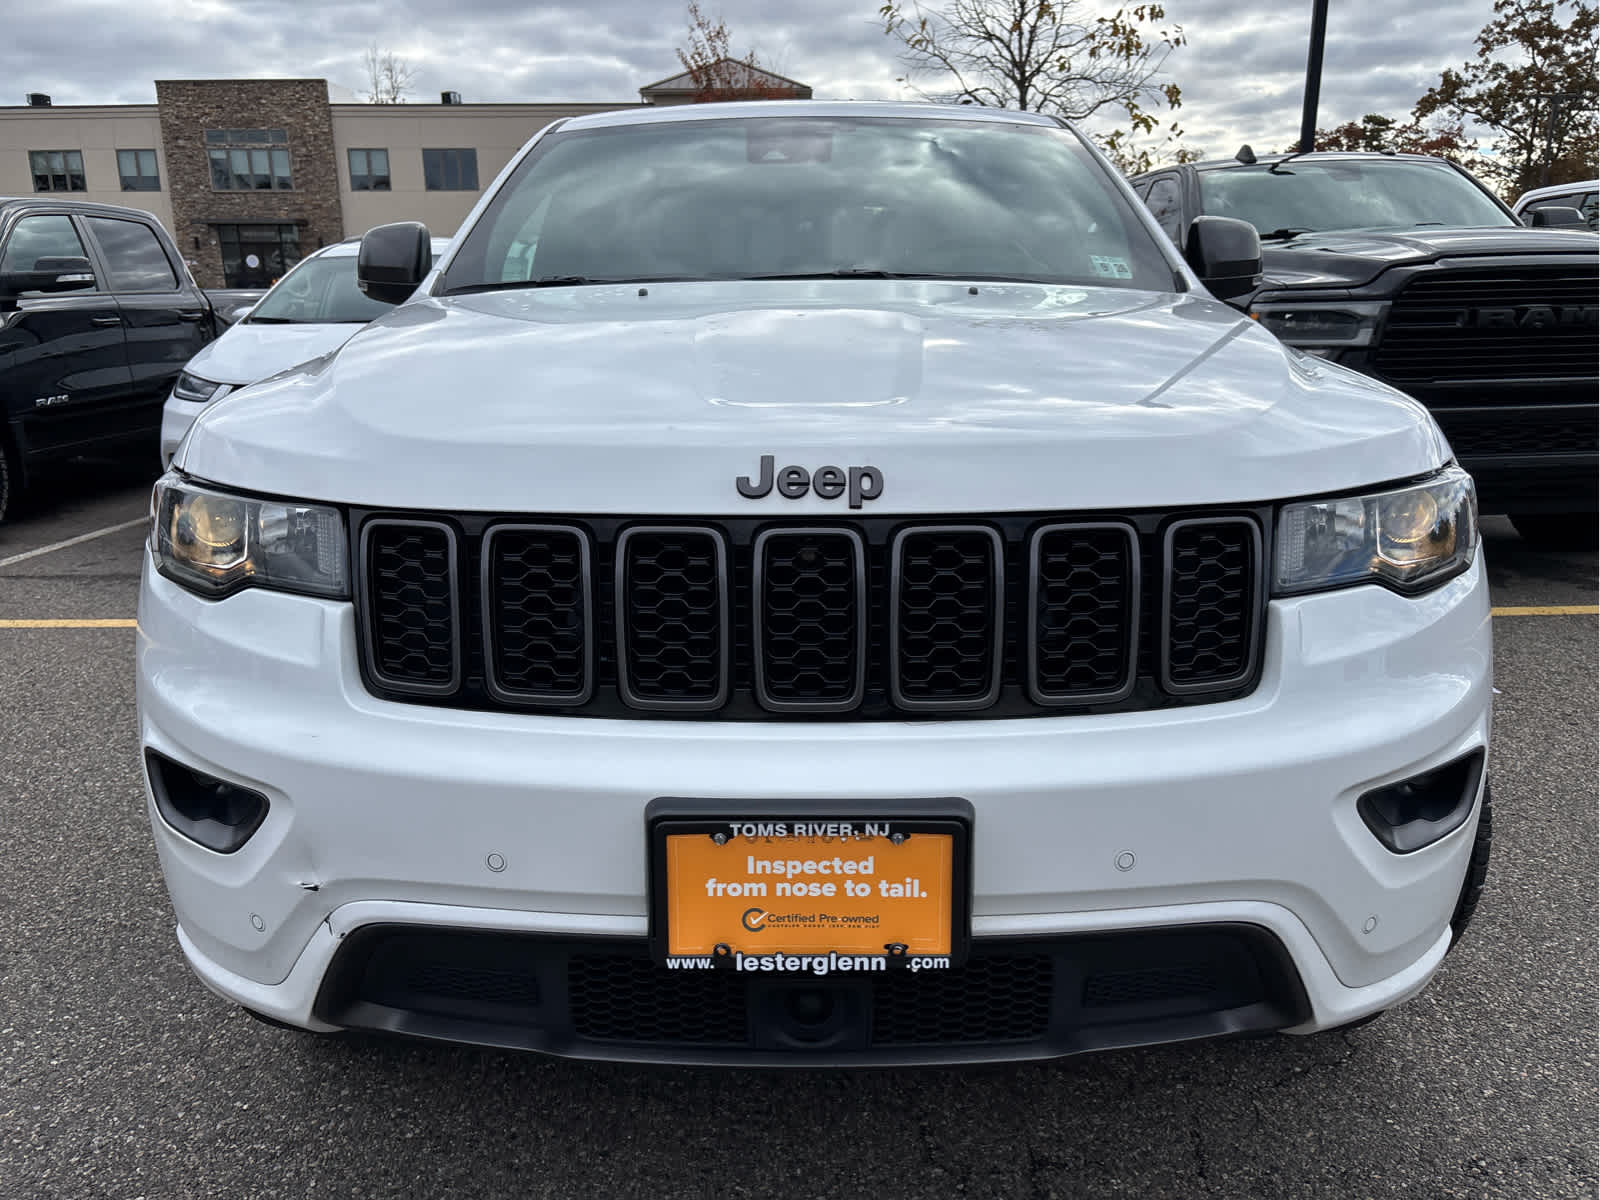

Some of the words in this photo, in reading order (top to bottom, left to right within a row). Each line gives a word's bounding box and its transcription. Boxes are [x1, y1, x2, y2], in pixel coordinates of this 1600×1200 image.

[35, 394, 69, 408] RAM
[735, 454, 885, 509] Jeep
[729, 823, 787, 837] TOMS
[794, 823, 859, 837] RIVER,
[865, 823, 890, 837] NJ
[747, 855, 875, 879] Inspected
[705, 878, 767, 897] from
[776, 882, 837, 897] nose
[844, 879, 871, 897] to
[878, 877, 928, 898] tail.
[767, 913, 816, 923] Certified
[666, 958, 715, 970] www.
[735, 952, 887, 975] lesterglenn
[906, 957, 950, 970] .com
